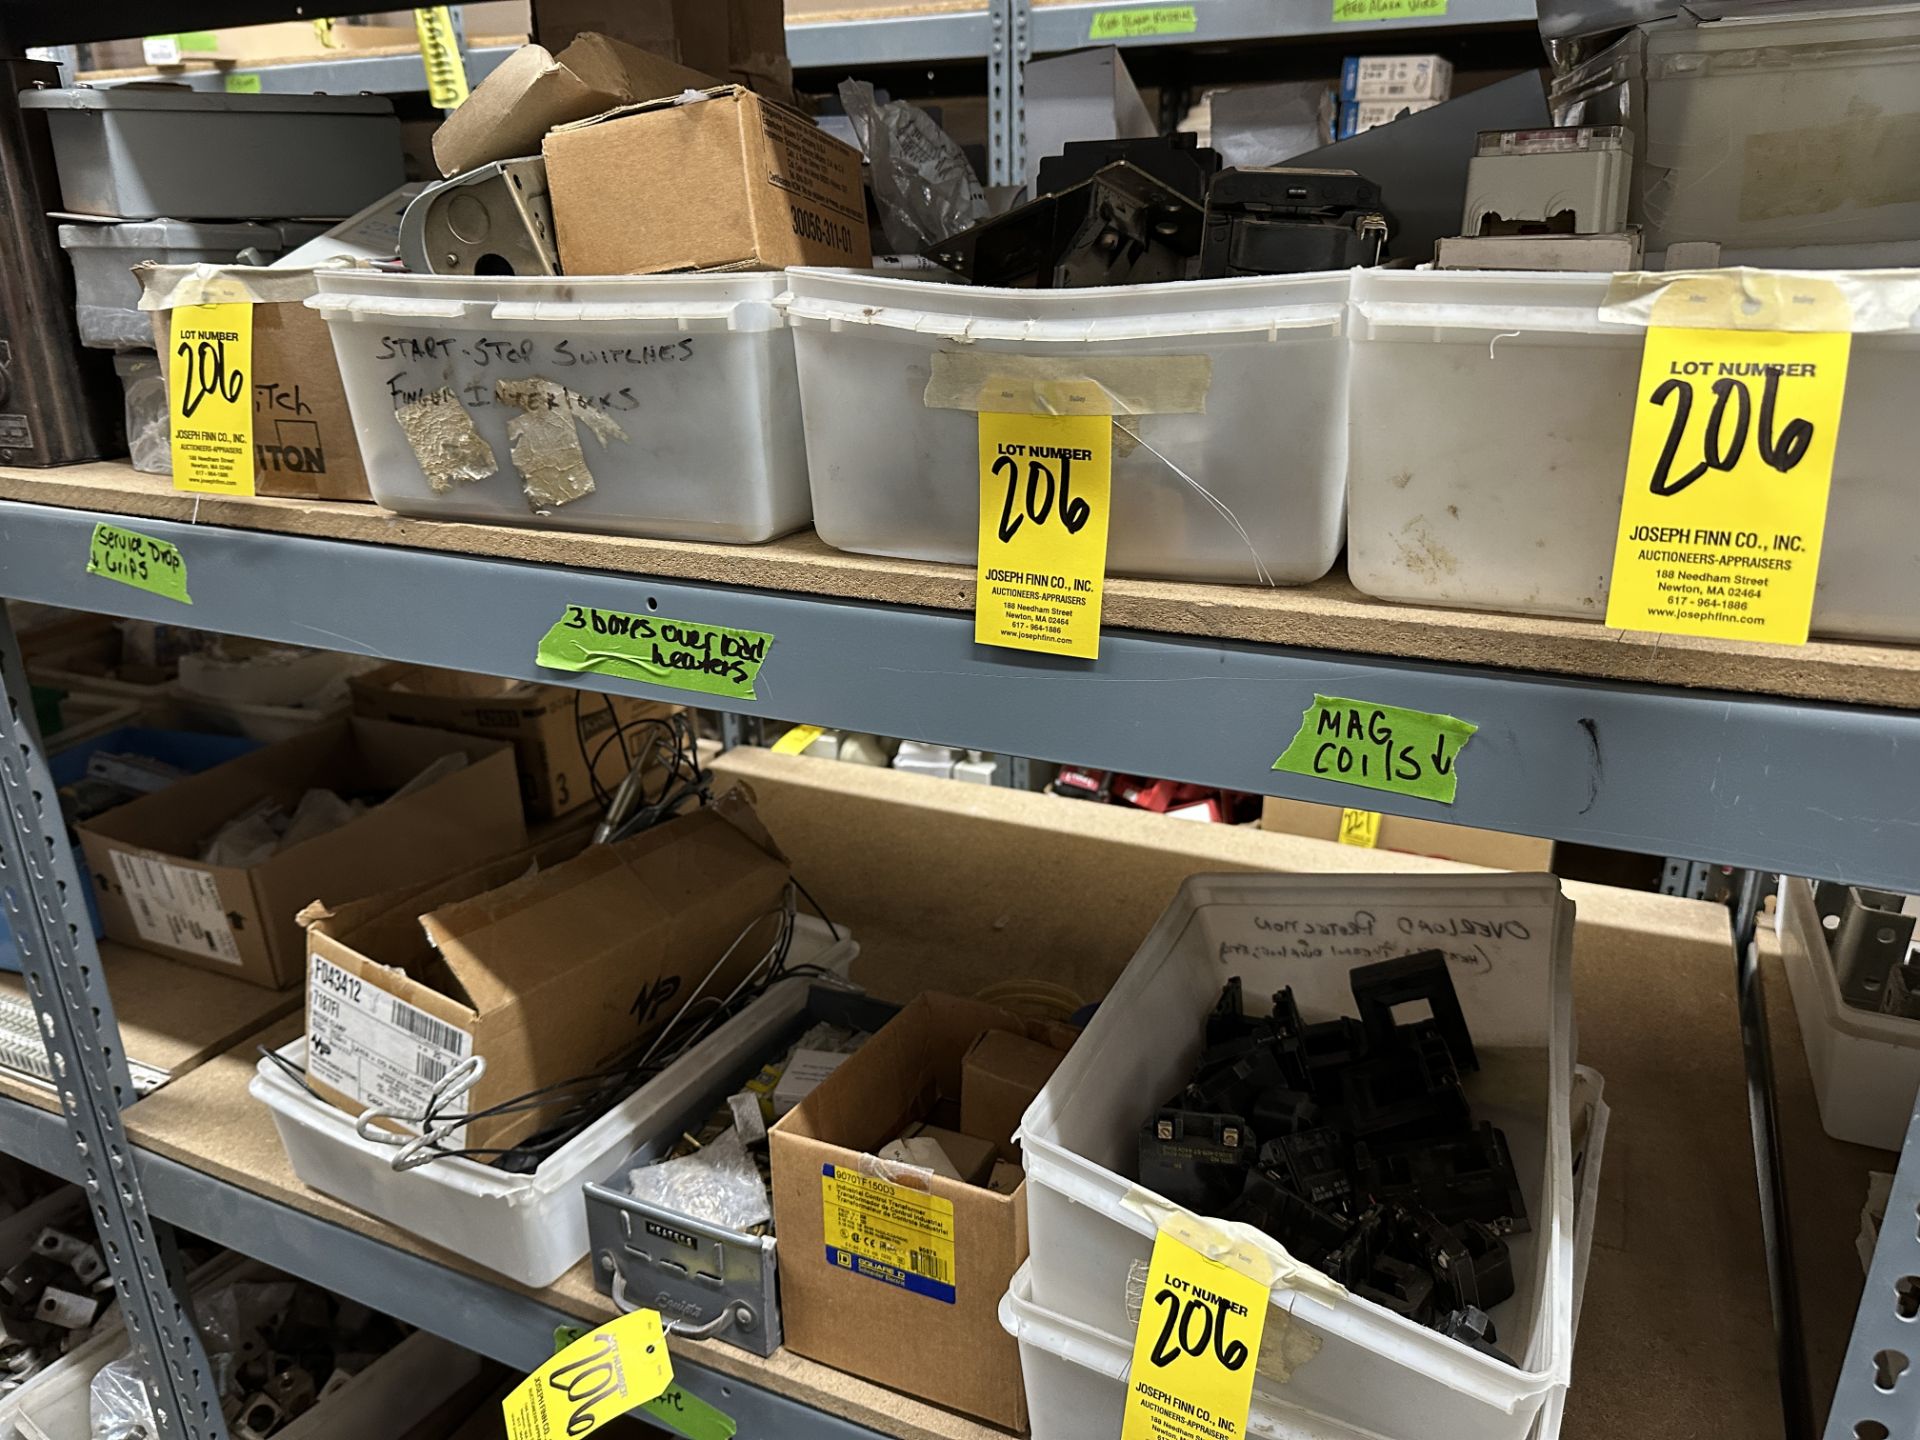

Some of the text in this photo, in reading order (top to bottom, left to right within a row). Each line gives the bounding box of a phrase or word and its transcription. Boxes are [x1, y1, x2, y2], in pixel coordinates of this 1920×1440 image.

[791, 205, 852, 254] 30056-311-01
[180, 330, 239, 342] LOT NUMBER
[552, 337, 693, 367] SWITCHES
[177, 339, 244, 419] 206
[1670, 361, 1817, 377] LOT NUMBER
[175, 430, 247, 444] JOSEPH FINN CO., INC.
[1649, 367, 1815, 497] 206
[998, 443, 1093, 461] LOT NUMBER
[992, 454, 1090, 543] 206
[1629, 525, 1806, 552] JOSEPH FINN CO., INC.
[147, 541, 180, 573] Drop
[1638, 550, 1792, 571] AUCTIONEERS-APPRAISERS
[985, 569, 1094, 593] JOSEPH FINN CO., INC.
[1655, 569, 1768, 587] 188 Needham Street
[1658, 582, 1762, 599] Newton, MA 02464
[992, 586, 1087, 606] AUCTIONEERS-APPRAISERS
[1667, 595, 1687, 605] 617
[1697, 598, 1748, 611] 964-1886
[564, 607, 587, 629] 3
[591, 609, 657, 639] boxes
[1006, 611, 1034, 622] Newton,
[1048, 617, 1069, 626] 02464
[1017, 604, 1050, 614] Needham
[1051, 608, 1073, 617] Street
[1647, 607, 1765, 625] www.josephfinn.com
[1000, 629, 1073, 645] www.josephfinn.com
[1030, 624, 1062, 634] 964-1886
[651, 643, 748, 684] heaters
[1317, 708, 1392, 745] MAG
[556, 773, 570, 804] 3
[835, 1170, 895, 1196] 9070TF150D3
[837, 1190, 880, 1208] Transformador
[890, 1206, 913, 1219] Control
[913, 1213, 943, 1228] Industrial
[865, 1191, 887, 1203] Control
[888, 1200, 926, 1216] Transformer
[1164, 1273, 1190, 1292] LOT
[1150, 1289, 1249, 1371] 206
[549, 1334, 619, 1437] 206
[1135, 1381, 1237, 1434] JOSEPH FINN CO., INC.
[1140, 1399, 1229, 1440] AUCTIONEERS-APPRAISERS
[1163, 1420, 1195, 1438] Needham
